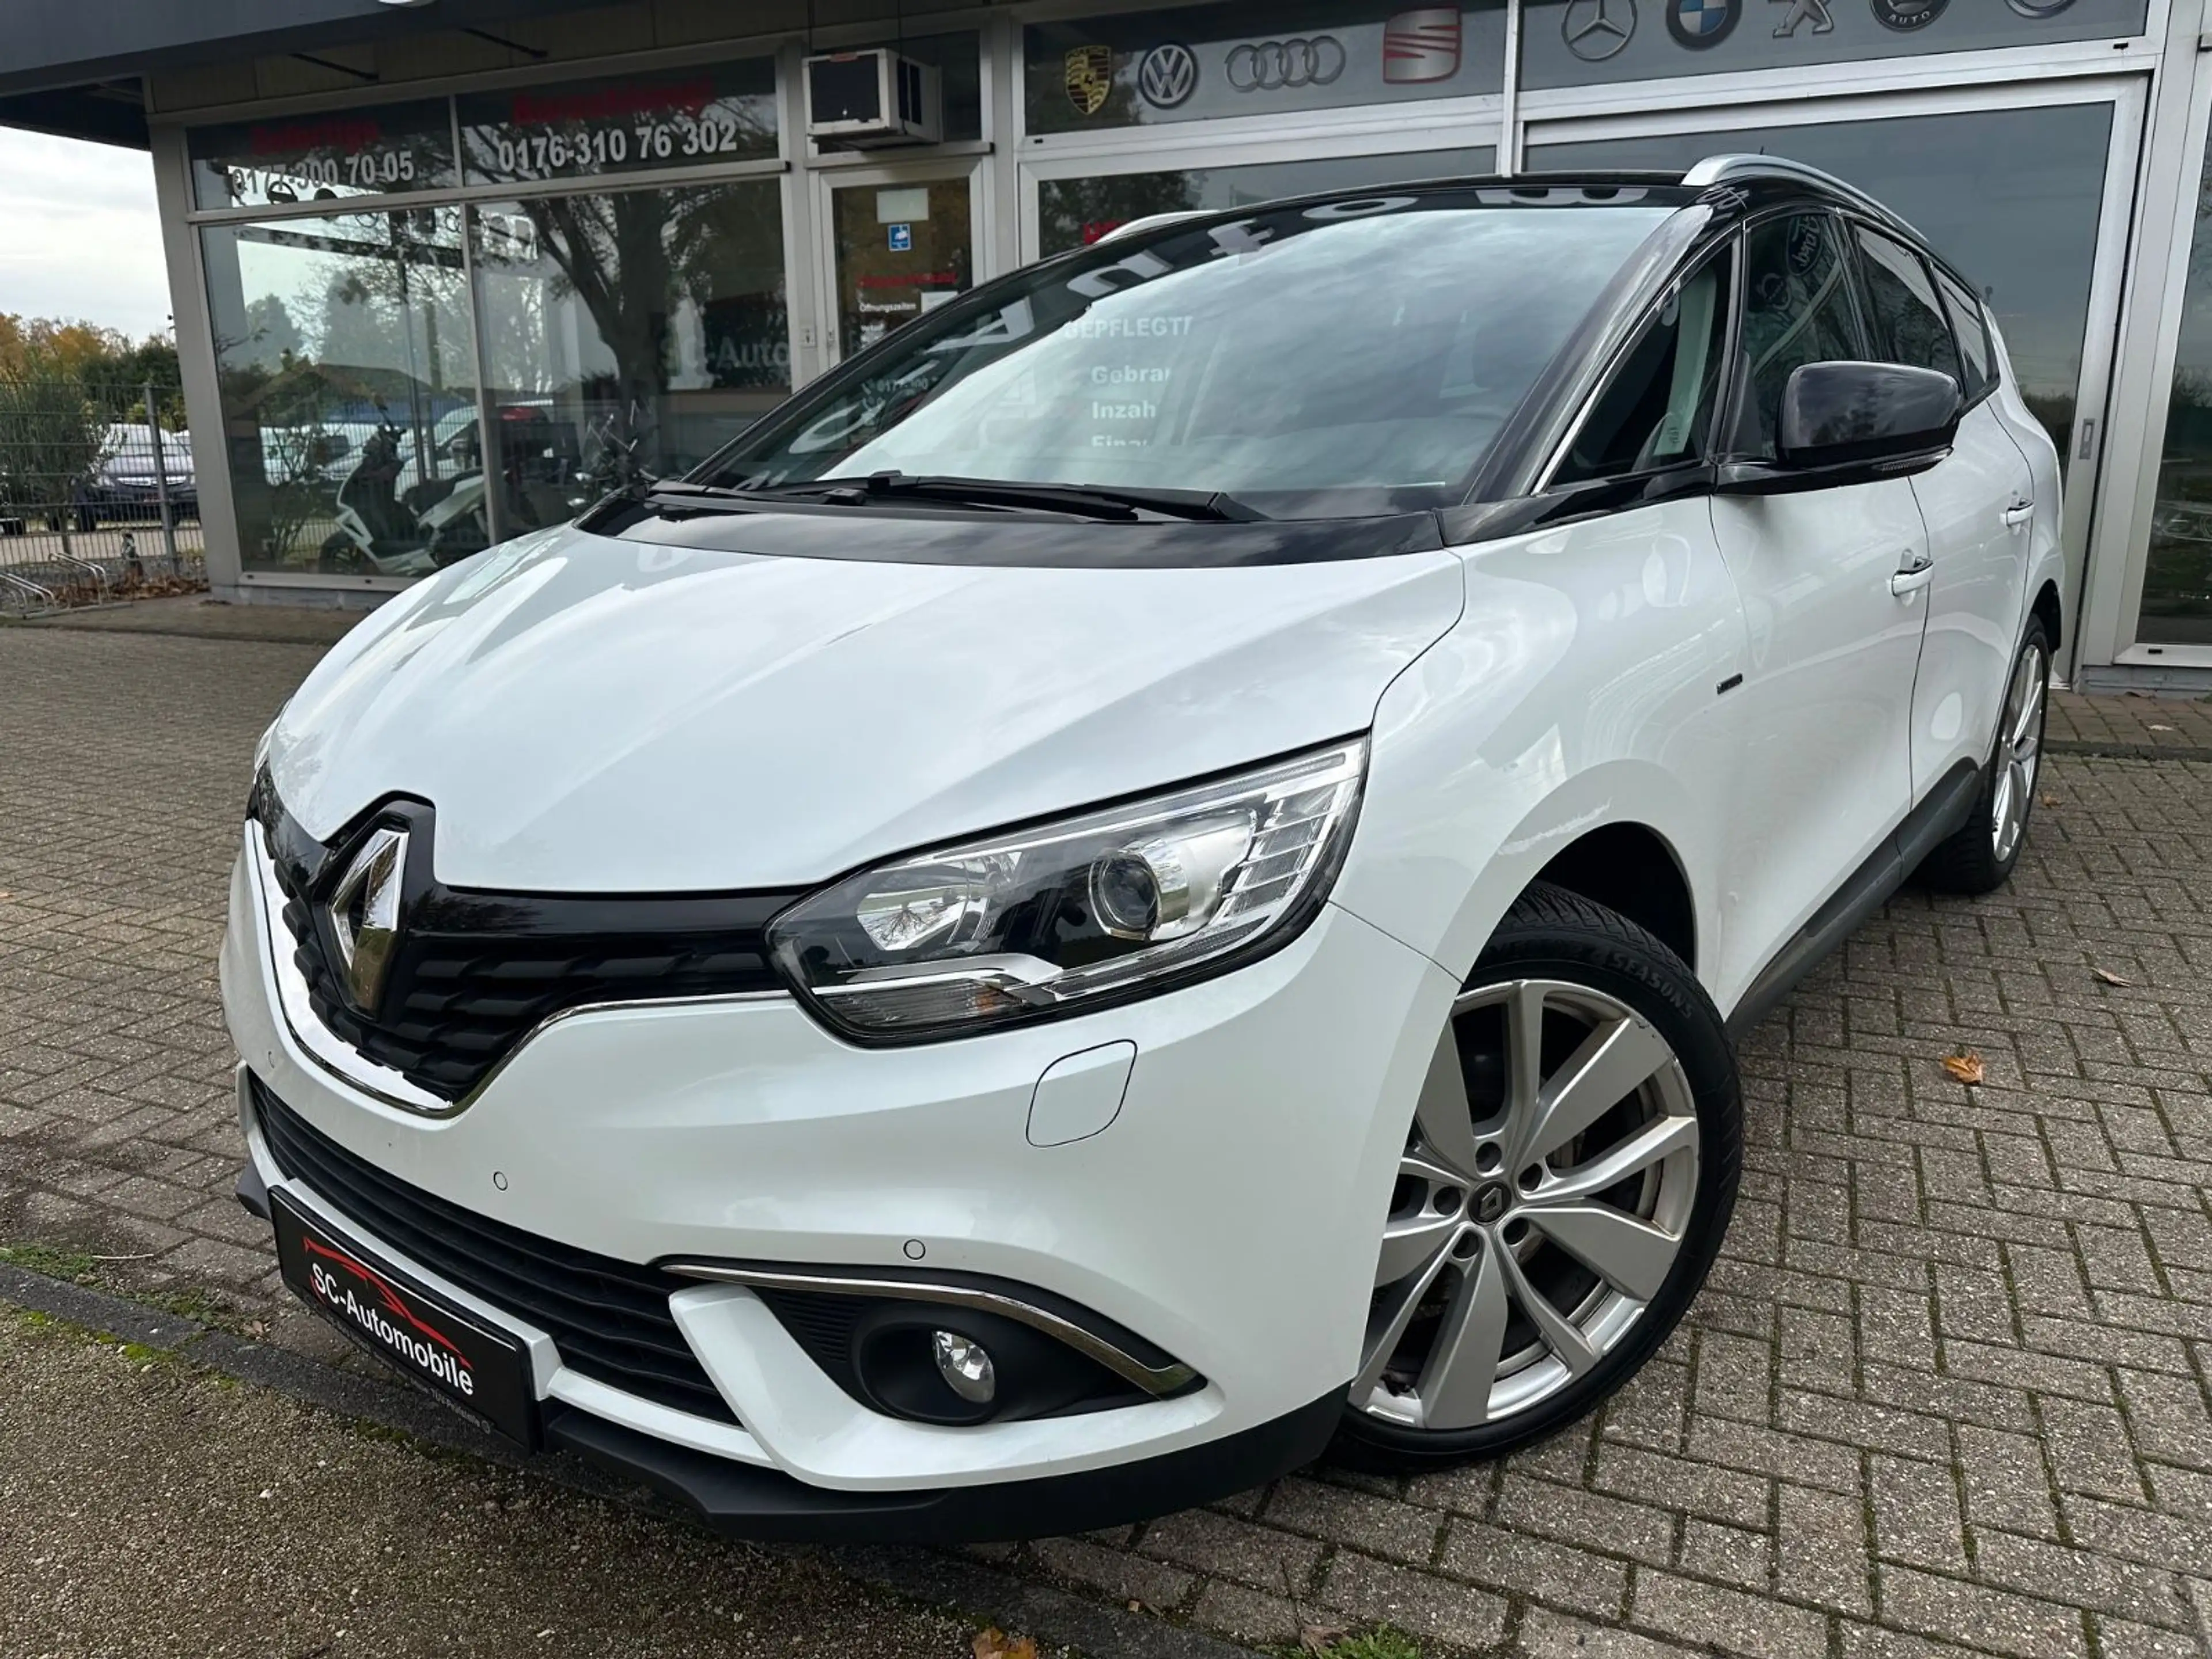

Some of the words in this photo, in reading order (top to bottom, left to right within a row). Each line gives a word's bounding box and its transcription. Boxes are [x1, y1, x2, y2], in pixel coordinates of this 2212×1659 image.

[1888, 10, 1930, 24] AUTO
[499, 128, 627, 172] 0176-310
[635, 123, 672, 158] 76
[682, 119, 737, 154] 302
[1092, 400, 1157, 419] Inzah
[312, 1262, 474, 1396] SC-Automobile
